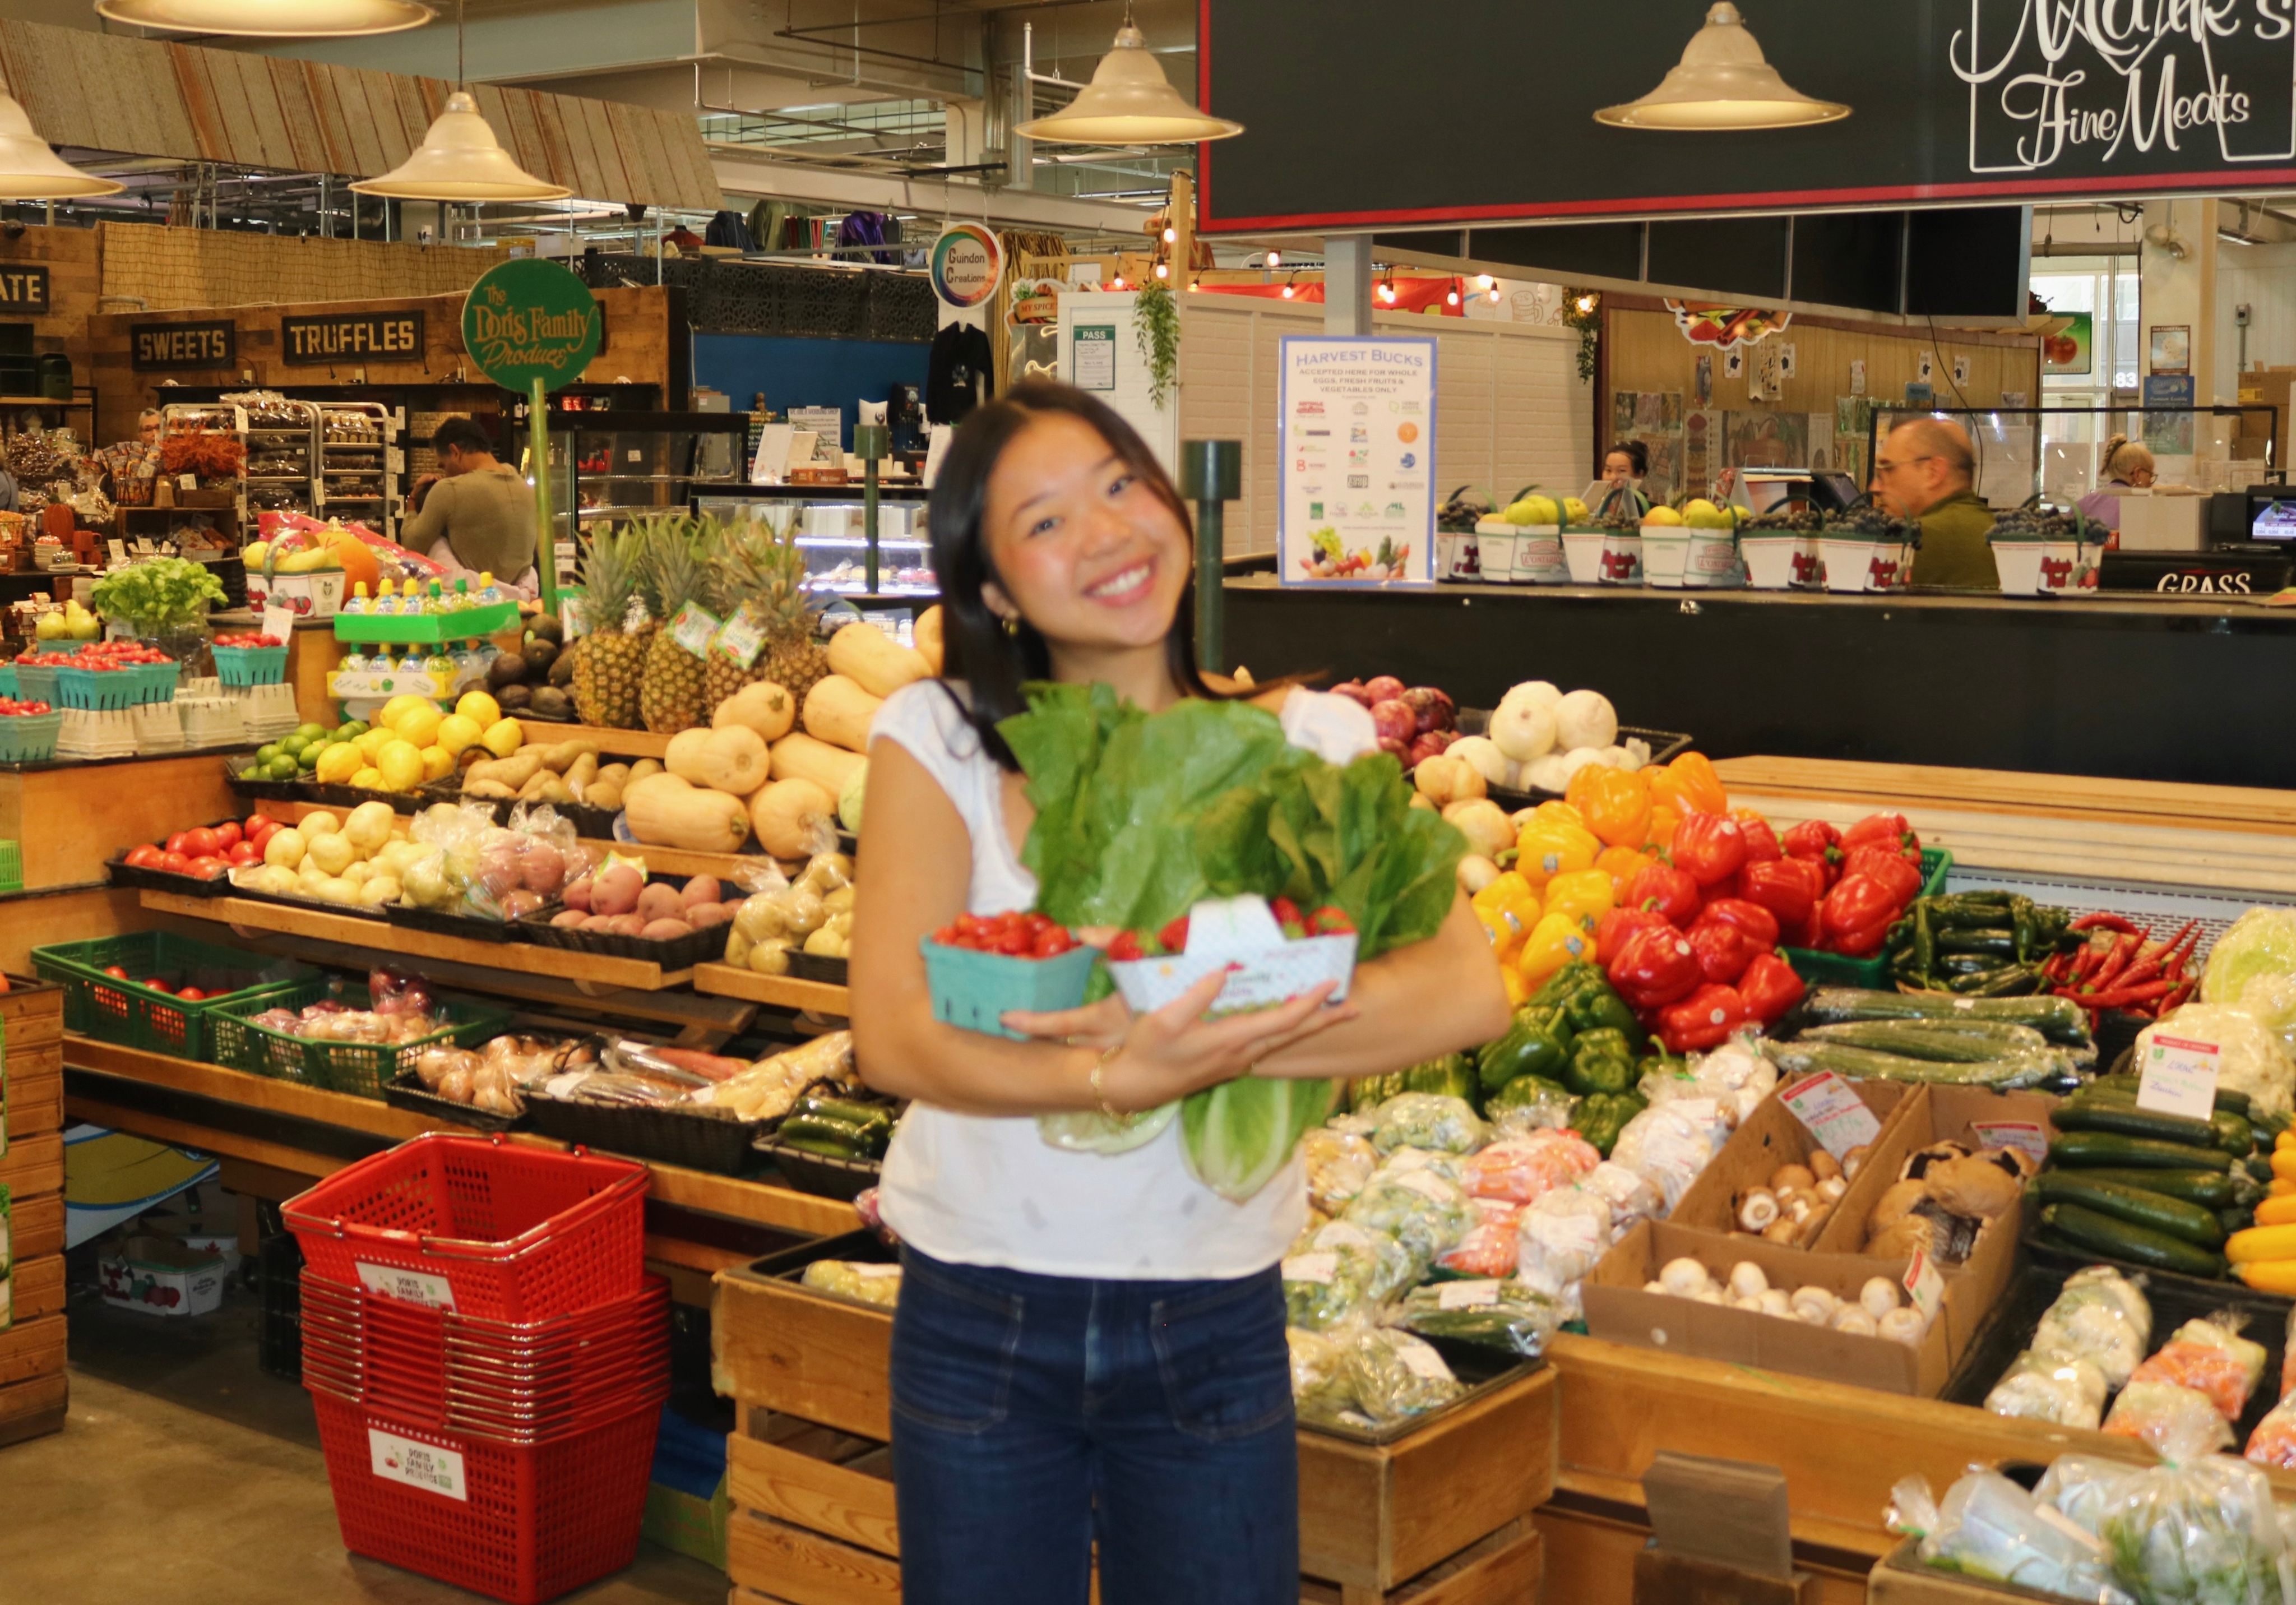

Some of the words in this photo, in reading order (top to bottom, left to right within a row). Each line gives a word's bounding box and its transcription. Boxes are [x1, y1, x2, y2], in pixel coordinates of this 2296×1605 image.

[2001, 70, 2116, 167] Fine
[2102, 54, 2249, 161] Meats
[948, 247, 985, 263] Guindon
[946, 266, 985, 284] Creations
[483, 283, 507, 307] The
[1034, 303, 1055, 312] SPICE
[290, 321, 414, 354] TRUFFLES
[473, 305, 528, 345] Doris
[528, 304, 599, 353] Family
[1082, 330, 1106, 340] PASS
[139, 330, 226, 361] SWEETS
[481, 339, 568, 371] Produce
[1296, 350, 1367, 367] HARVEST
[1371, 349, 1423, 367] BUCKS
[2116, 372, 2137, 387] 83
[406, 1457, 434, 1473] FAMILY
